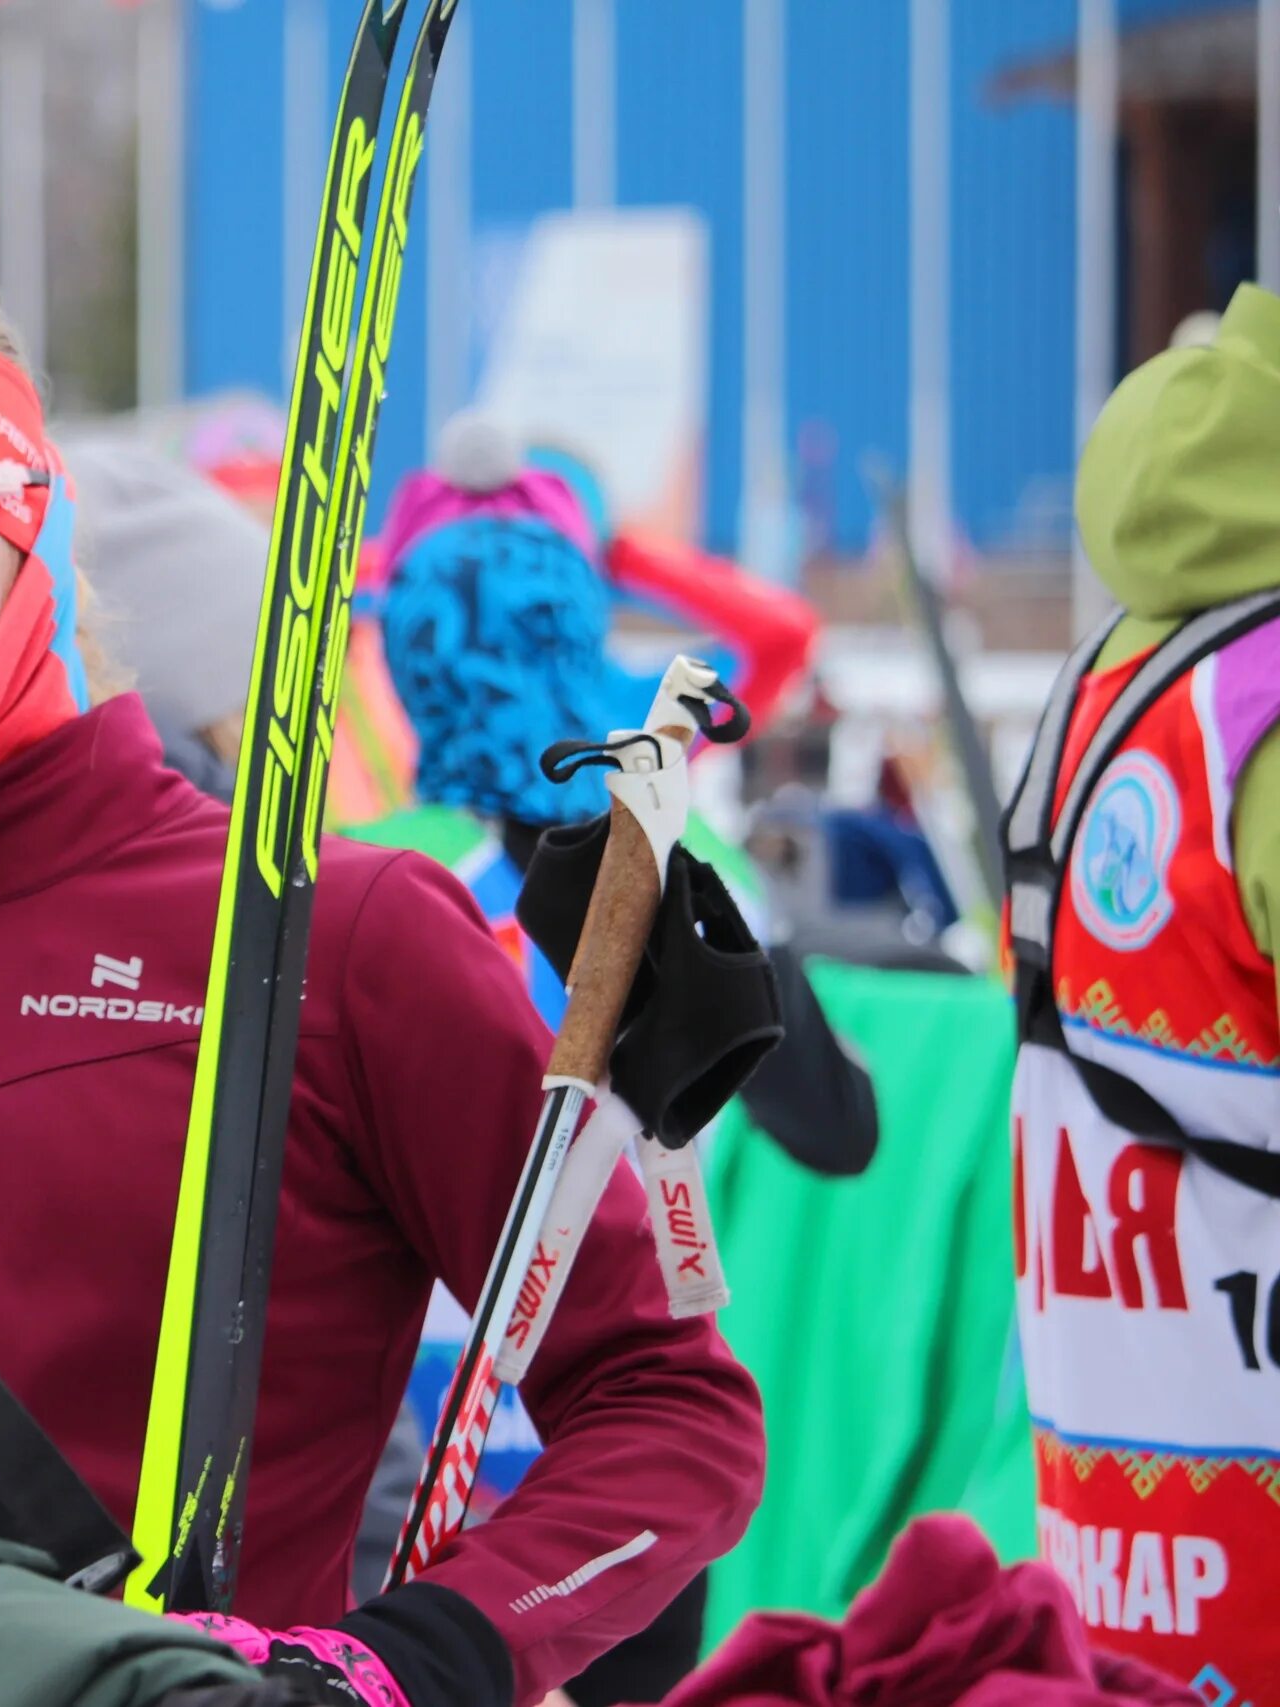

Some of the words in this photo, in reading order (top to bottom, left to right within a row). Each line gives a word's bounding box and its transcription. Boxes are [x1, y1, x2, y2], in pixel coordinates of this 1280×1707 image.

[257, 116, 376, 899] FISCHER
[302, 111, 424, 884] FISCHER
[1213, 1269, 1280, 1372] 1
